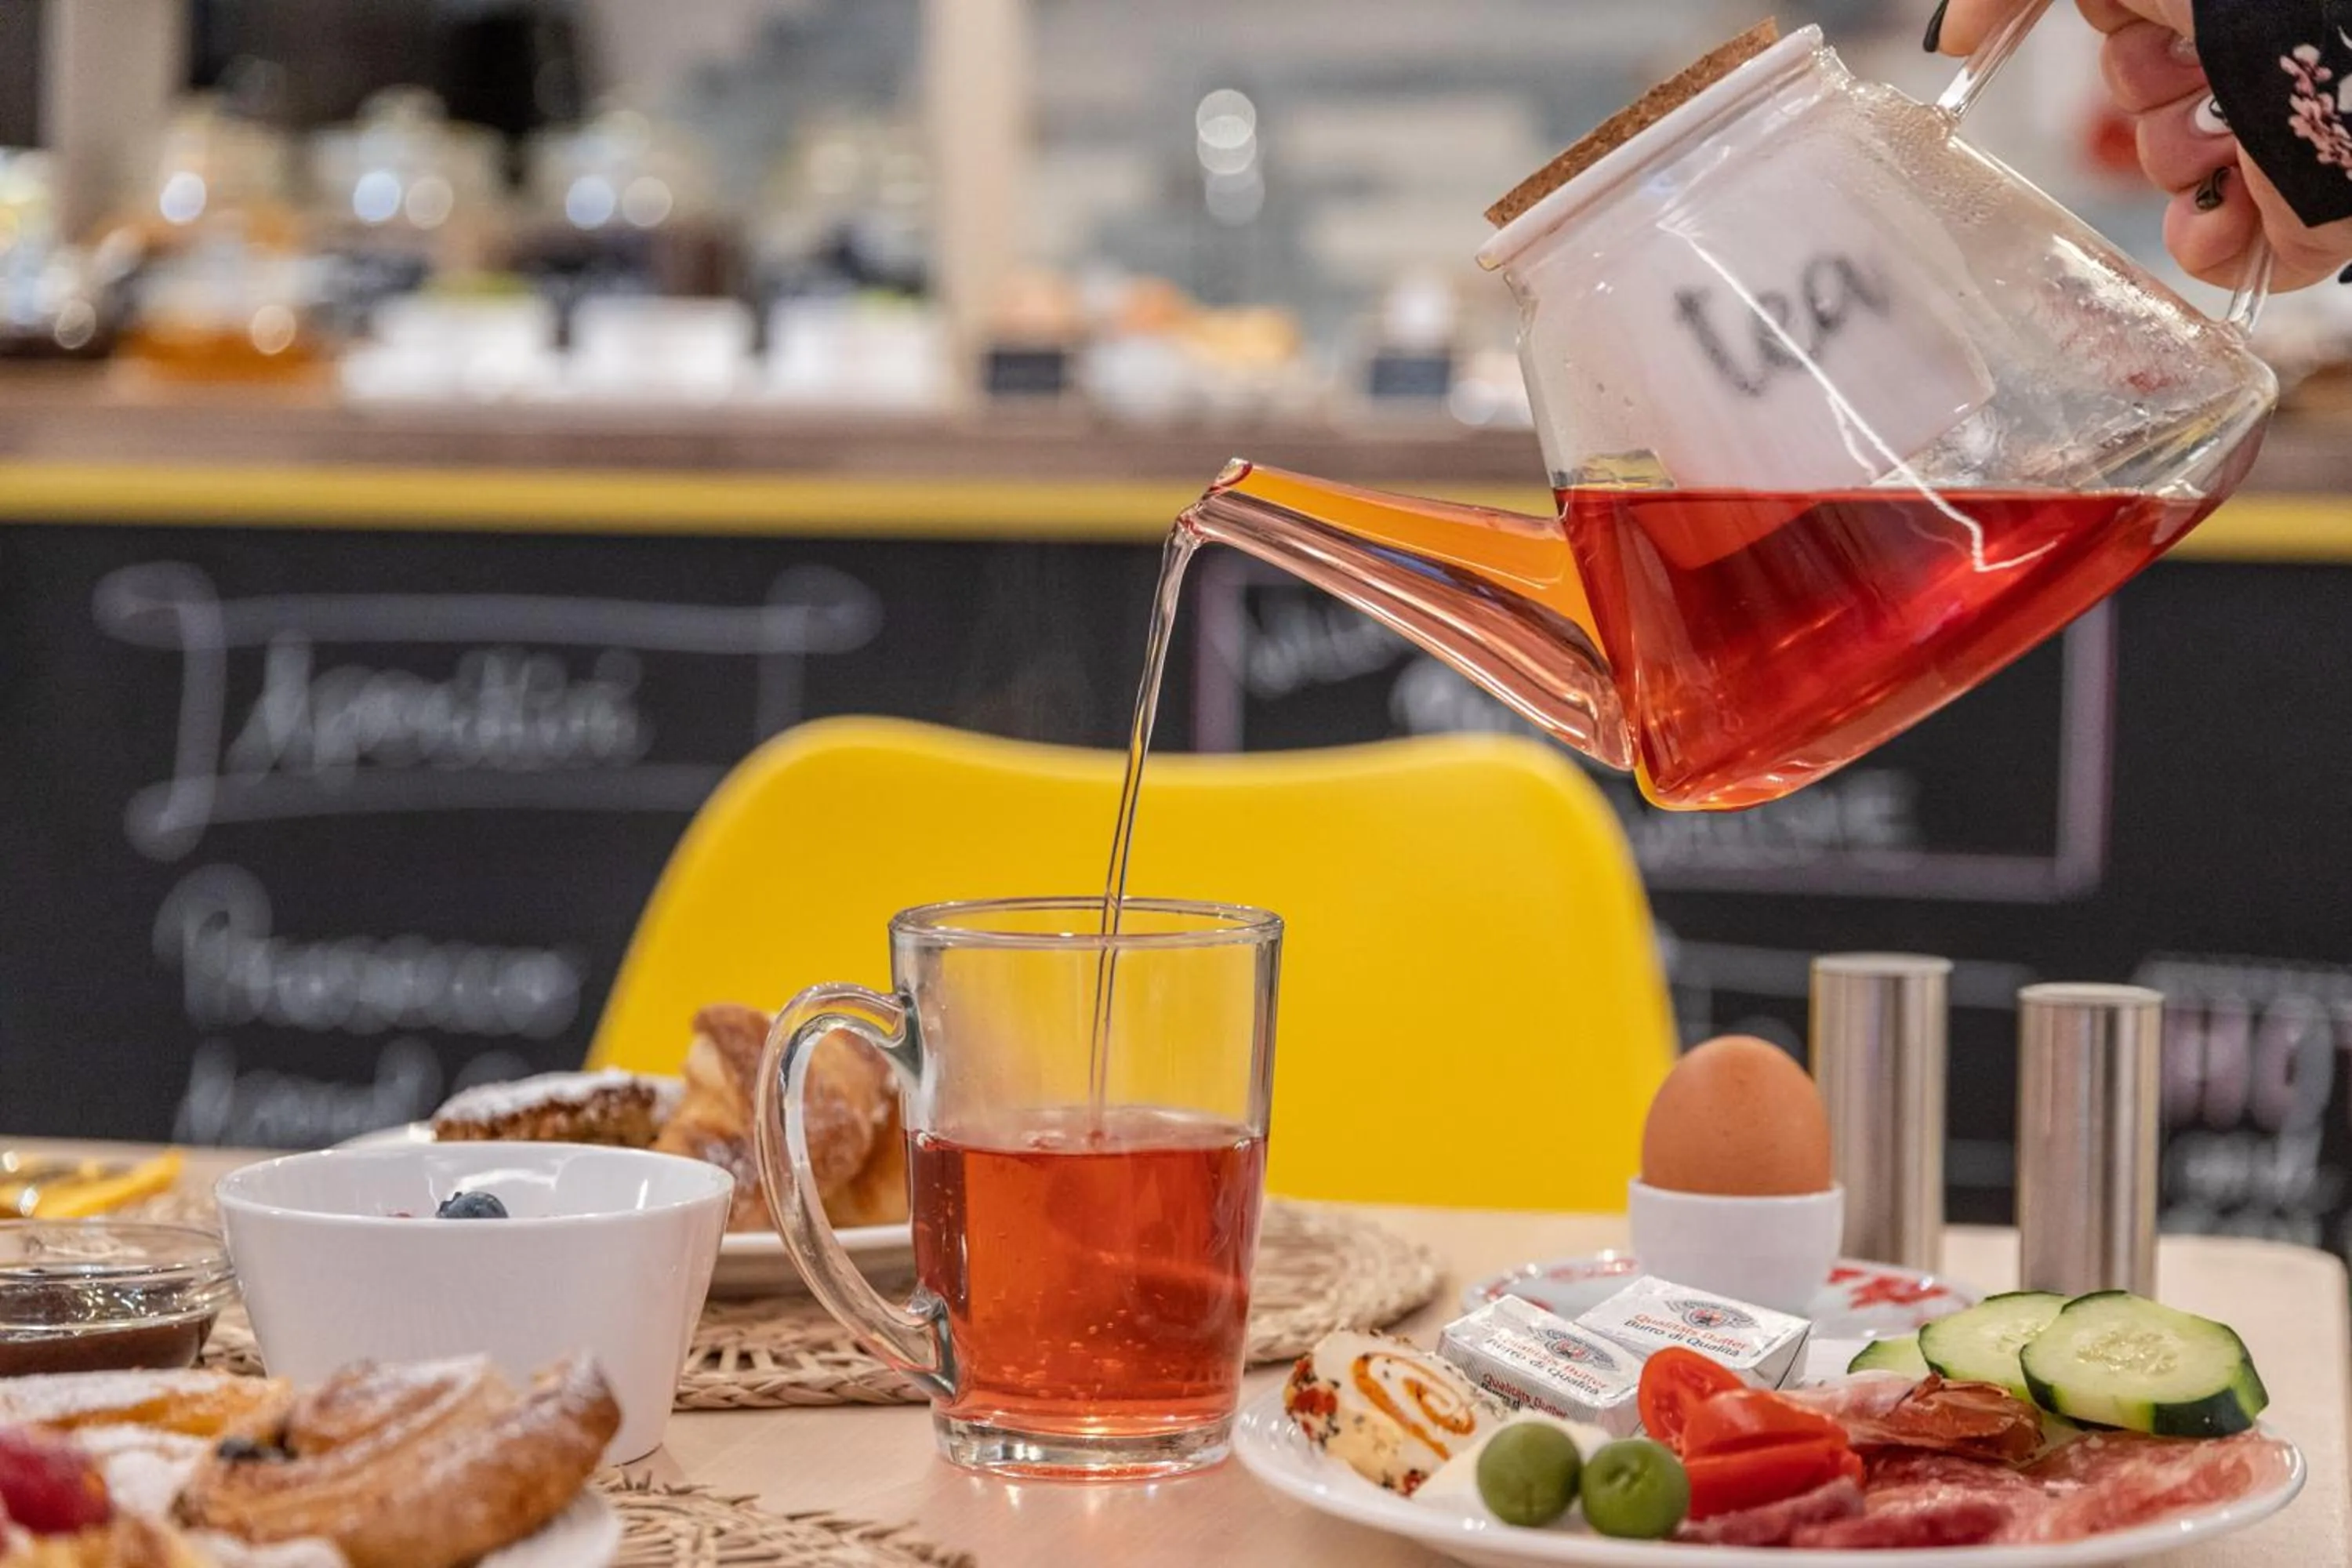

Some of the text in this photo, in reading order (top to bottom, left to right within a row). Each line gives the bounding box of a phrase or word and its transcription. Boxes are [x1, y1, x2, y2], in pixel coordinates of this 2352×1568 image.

[1624, 1319, 1665, 1335] Burro
[1668, 1332, 1683, 1341] di
[1701, 1331, 1749, 1350] Butter
[1563, 1364, 1609, 1388] Butter
